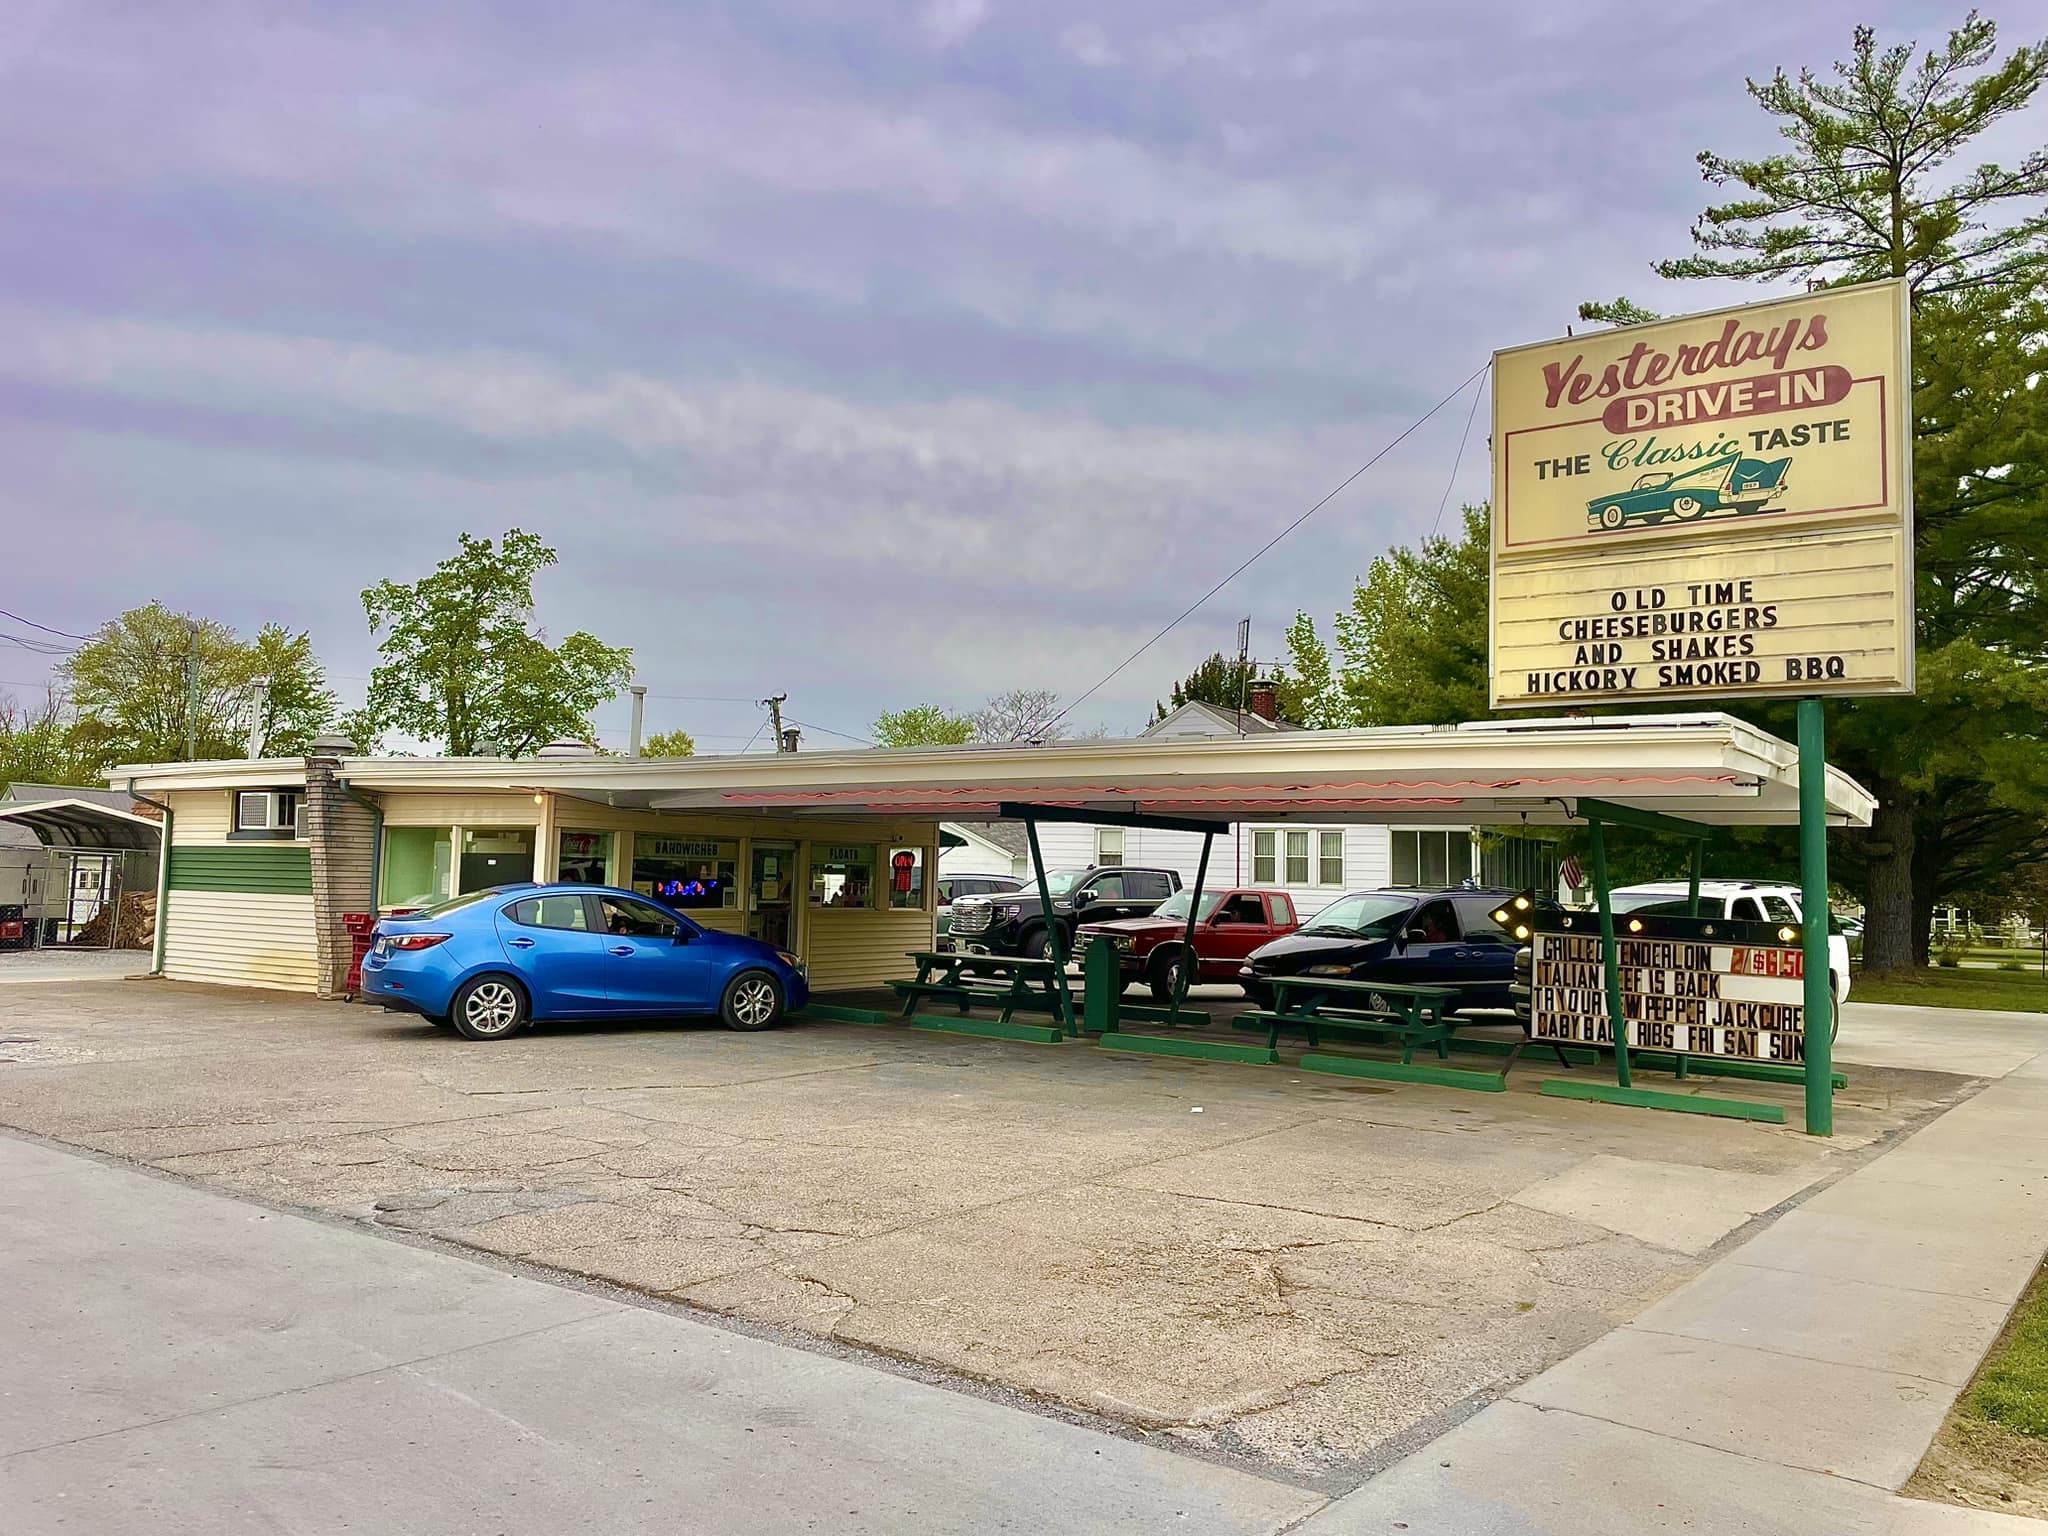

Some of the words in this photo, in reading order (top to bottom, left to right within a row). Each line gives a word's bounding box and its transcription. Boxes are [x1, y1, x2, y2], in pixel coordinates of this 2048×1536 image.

[1542, 314, 1829, 408] Yesterdays
[1626, 369, 1826, 429] DRIVE-IN
[1534, 454, 1590, 480] THE
[1601, 432, 1740, 471] Classic
[1749, 419, 1850, 451] TASTE
[1611, 587, 1666, 611] OLD
[1688, 580, 1754, 605] TIME
[1559, 606, 1778, 641] CHEESEBURGERS
[1575, 642, 1623, 665] AND
[1652, 634, 1754, 661] SHAKES
[1528, 667, 1637, 693] HICKORY
[1659, 660, 1760, 688] SMOKED
[1786, 656, 1845, 681] BBQ
[655, 842, 718, 856] SANDWICHES
[894, 855, 916, 867] OPEN
[1615, 943, 1711, 970] ENDERLOIN
[1537, 962, 1599, 987] ITALIAN
[1650, 972, 1664, 993] IS
[1675, 974, 1720, 998] BACK
[1646, 996, 1705, 1023] PEPPER
[1712, 1003, 1757, 1028] JACK
[1538, 1013, 1578, 1038] BABY
[1637, 1023, 1674, 1048] RIBS
[1689, 1027, 1713, 1052] FRI
[1725, 1031, 1758, 1056] SAT
[1770, 1034, 1804, 1060] SUN
